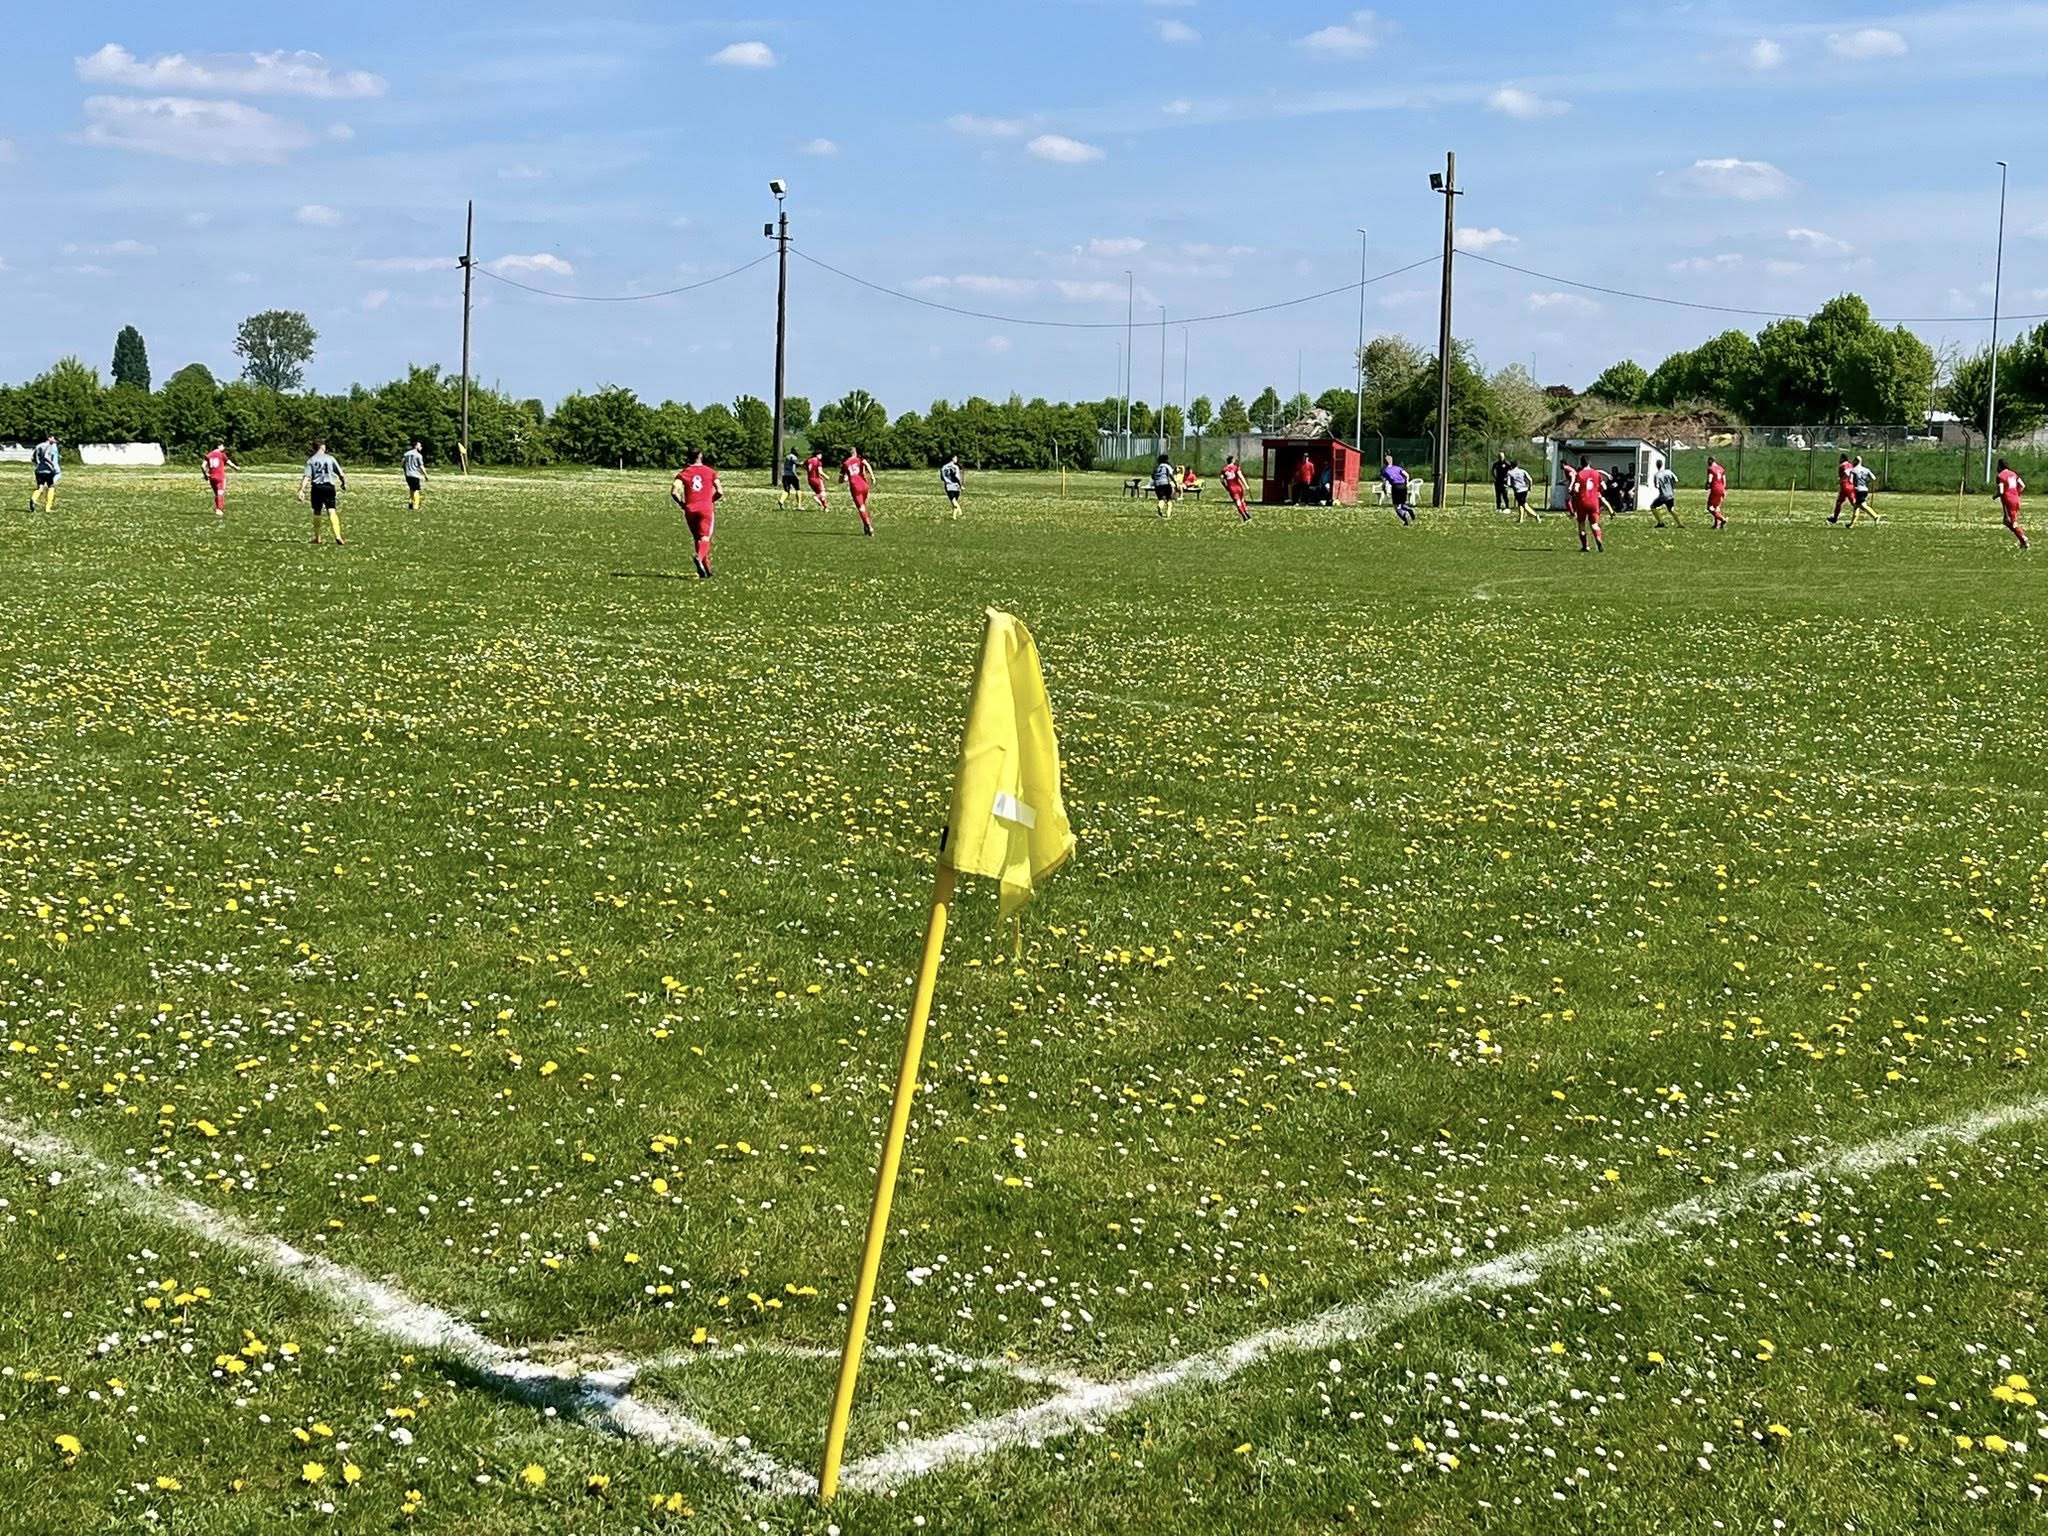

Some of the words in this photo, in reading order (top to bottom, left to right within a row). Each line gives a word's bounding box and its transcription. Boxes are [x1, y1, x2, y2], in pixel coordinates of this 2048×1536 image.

[314, 461, 329, 475] 24
[691, 474, 703, 493] 8
[1586, 477, 1594, 491] 6
